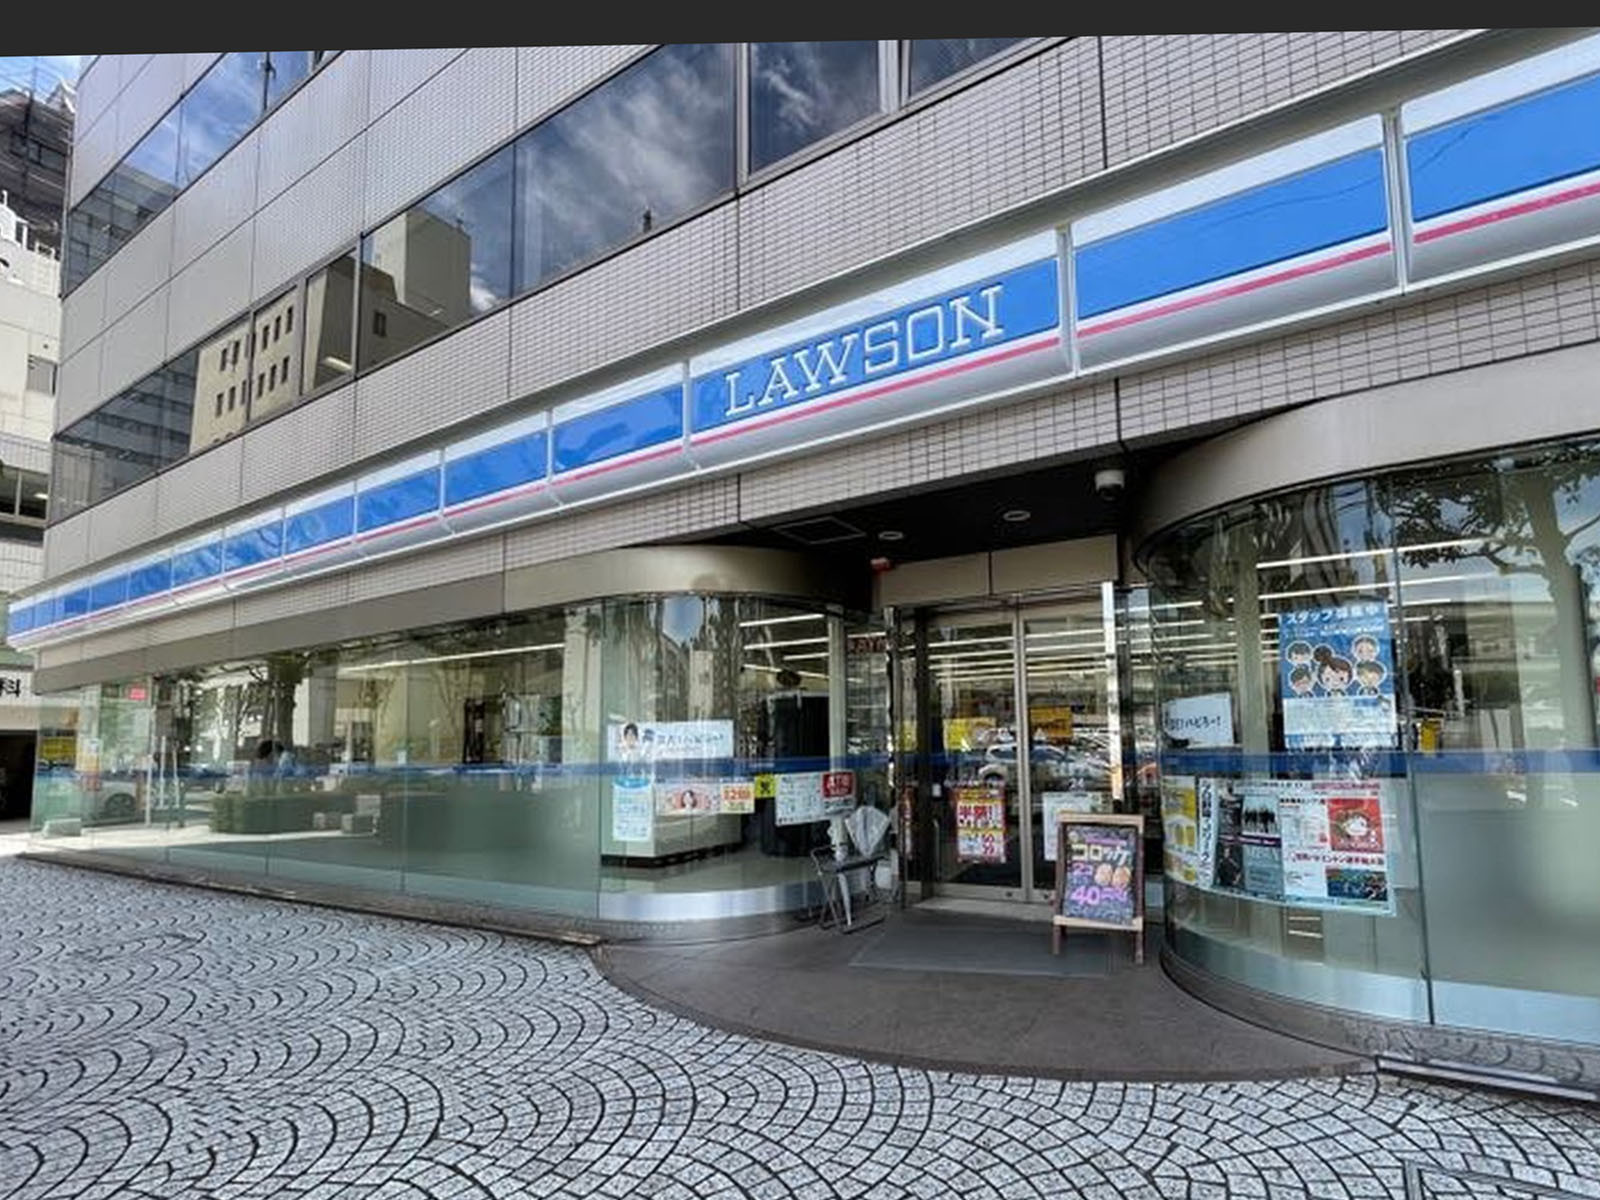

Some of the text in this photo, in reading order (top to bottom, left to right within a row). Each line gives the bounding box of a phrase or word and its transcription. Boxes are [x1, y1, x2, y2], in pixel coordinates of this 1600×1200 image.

[724, 284, 1005, 417] LAWSON
[1071, 843, 1130, 866] コロッケ
